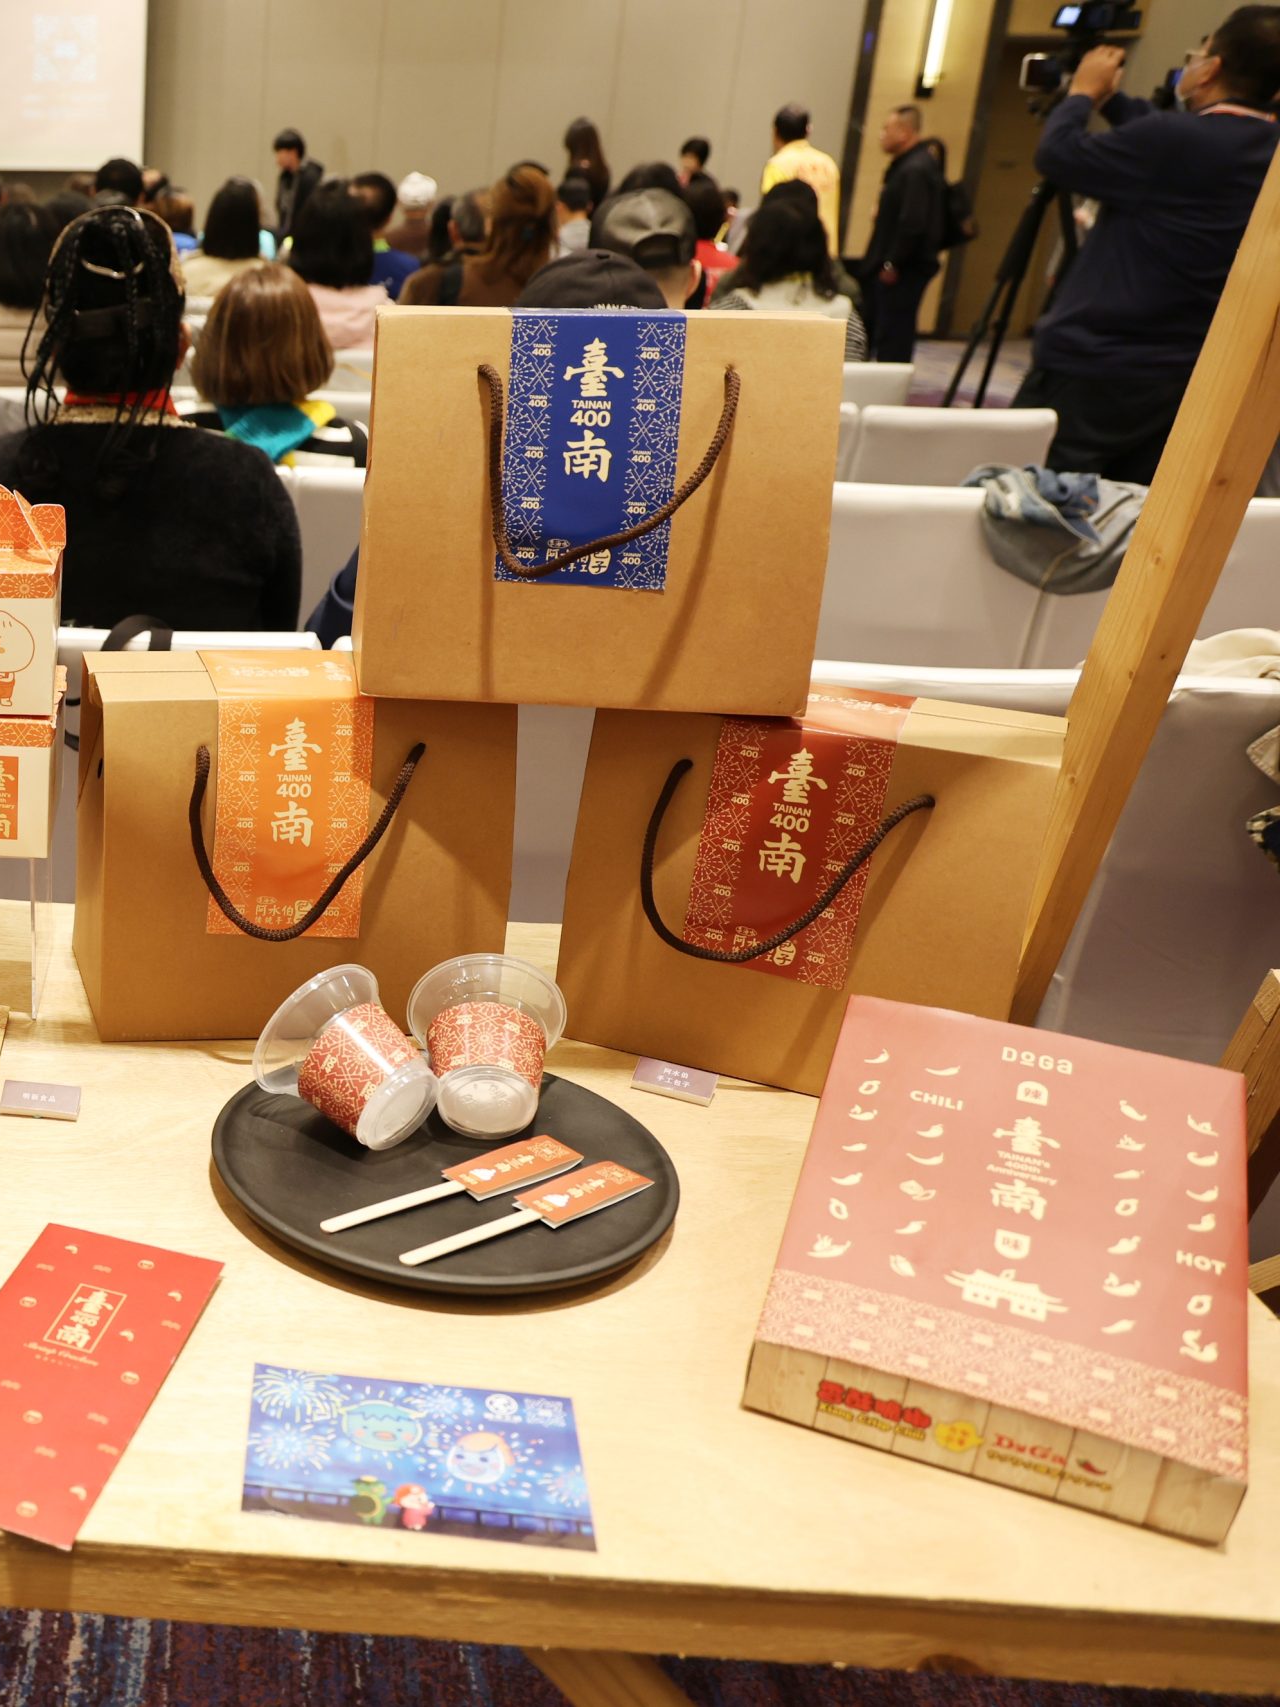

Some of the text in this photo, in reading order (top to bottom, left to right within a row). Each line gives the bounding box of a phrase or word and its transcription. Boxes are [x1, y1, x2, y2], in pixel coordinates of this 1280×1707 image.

[532, 348, 551, 356] 400
[640, 351, 660, 360] 400
[563, 337, 625, 398] 臺
[528, 399, 547, 408] 400
[571, 400, 612, 410] TAINAN
[636, 403, 656, 412] 400
[570, 410, 611, 427] 400
[524, 450, 543, 458] 400
[562, 430, 612, 483] 南
[631, 455, 651, 464] 400
[520, 501, 540, 510] 400
[627, 506, 646, 514] 400
[516, 551, 535, 559] 400
[622, 556, 641, 565] 400
[335, 728, 352, 736] 400
[268, 716, 322, 772] 臺
[740, 749, 759, 758] 400
[238, 774, 256, 782] 400
[276, 774, 312, 782] TAINAN
[767, 748, 828, 804] 臺
[846, 768, 866, 778] 400
[334, 775, 351, 783] 400
[276, 784, 312, 798] 400
[730, 796, 750, 806] 400
[773, 802, 812, 818] TAINAN
[270, 800, 314, 847] 南
[330, 821, 348, 829] 400
[770, 813, 810, 833] 400
[836, 816, 855, 826] 400
[722, 842, 740, 852] 400
[758, 832, 807, 884] 南
[713, 887, 732, 897] 400
[704, 932, 723, 941] 400
[806, 955, 825, 965] 400
[910, 1090, 965, 1112] CHILI
[992, 1116, 1061, 1156] 臺
[996, 1150, 1051, 1169] TAINAN's
[1004, 1160, 1041, 1175] 400th
[986, 1164, 1058, 1187] Anniversary
[989, 1178, 1048, 1222] 南
[1176, 1250, 1227, 1276] HOT
[56, 1323, 91, 1349] 南
